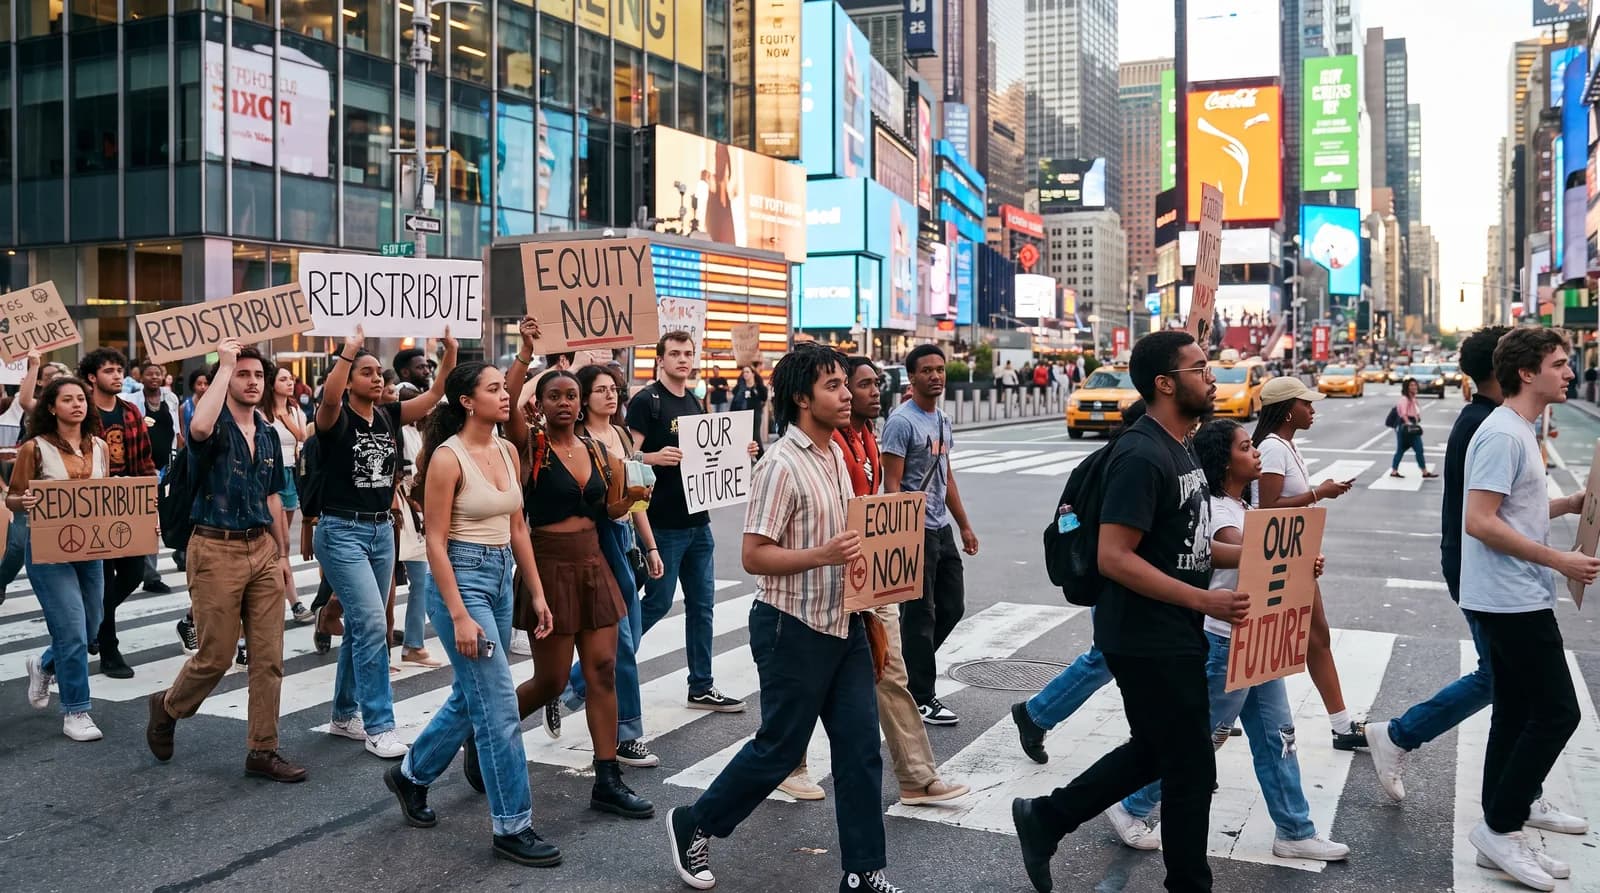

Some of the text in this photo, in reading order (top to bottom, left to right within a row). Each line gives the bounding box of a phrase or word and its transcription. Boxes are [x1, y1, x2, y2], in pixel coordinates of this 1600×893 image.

[760, 35, 796, 45] EQUITY
[766, 48, 790, 58] NOW
[534, 244, 646, 291] EQUITY
[309, 270, 479, 322] REDISTRIBUTE
[560, 293, 634, 339] NOW
[2, 318, 75, 355] FUTURE
[14, 311, 38, 326] FOR
[145, 290, 310, 356] REDISTRIBUTE
[696, 416, 732, 449] OUR
[32, 484, 157, 522] REDISTRIBUTE
[687, 466, 746, 510] FUTURE
[865, 498, 923, 537] EQUITY
[1263, 515, 1306, 560] OUR
[872, 544, 920, 590] NOW
[1230, 605, 1311, 683] FUTURE
